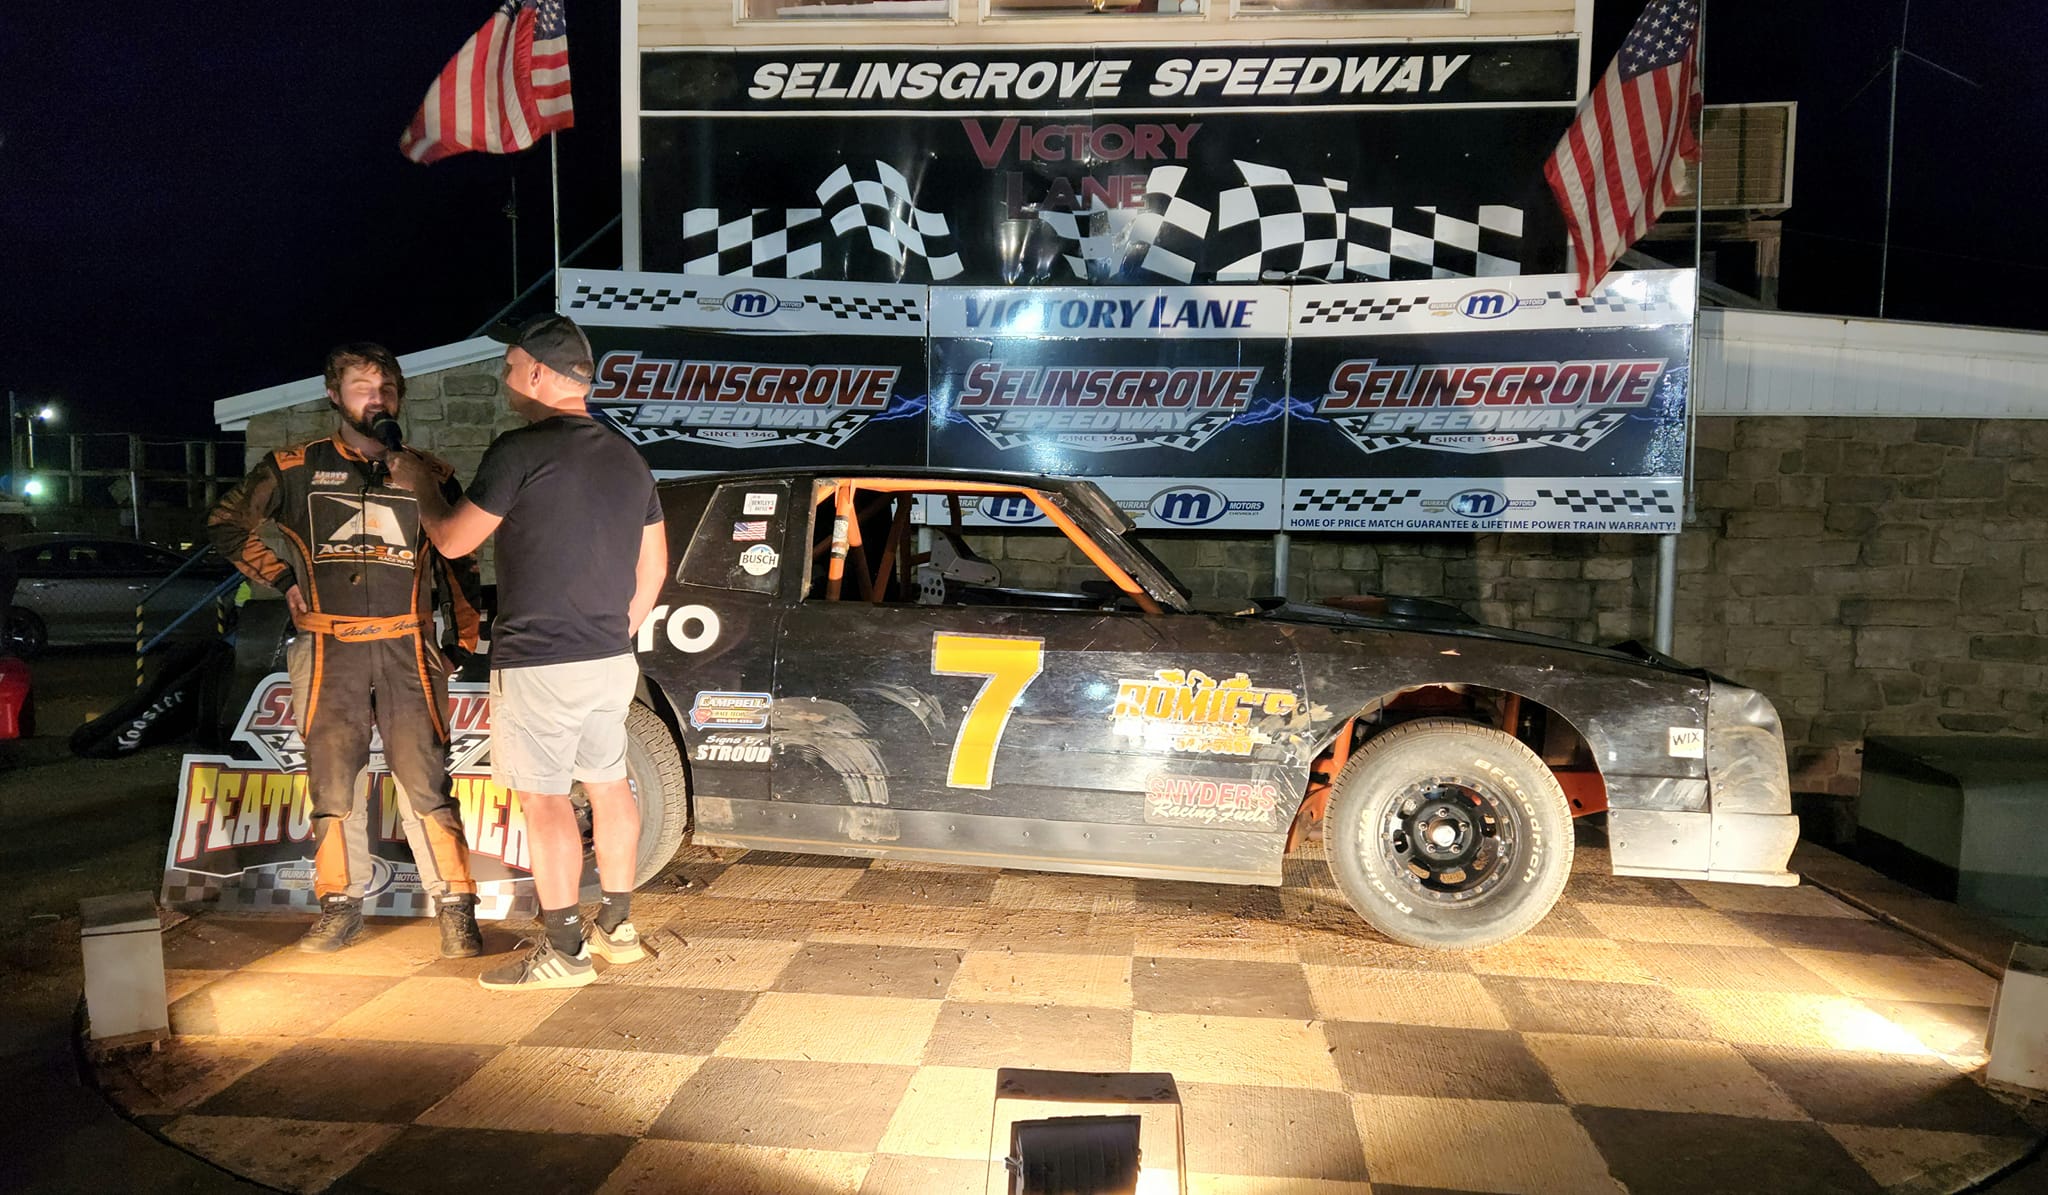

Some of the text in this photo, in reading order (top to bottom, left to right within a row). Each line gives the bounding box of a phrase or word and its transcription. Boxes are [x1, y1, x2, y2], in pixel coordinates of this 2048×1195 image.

[748, 54, 1470, 99] SELINSGROVE SPEEDWAY
[961, 118, 1203, 169] VICTORY
[1006, 171, 1148, 220] LANE
[1148, 295, 1257, 328] LANE
[591, 353, 898, 408] SELINSGROVE
[957, 362, 1260, 408] SELINSGROVE
[1323, 362, 1665, 408] SELINSGROVE
[637, 404, 841, 427] SPEEDWAY
[1002, 411, 1196, 432] SPEEDWAY
[1367, 409, 1592, 432] SPEEDWAY
[702, 430, 776, 439] SINCE 1946
[1062, 435, 1099, 443] SINCE
[1435, 435, 1516, 443] SINCE 1946
[1115, 501, 1149, 509] MURRAY
[1229, 501, 1262, 510] MOTORS
[1290, 518, 1676, 531] HOME OF PRICE MATCH GUARANTEE & LIFETIME POWER TRAIN WARRANTY!
[318, 543, 414, 560] ACCELO
[742, 554, 777, 566] BUSCH
[931, 630, 1045, 790] 7
[1672, 731, 1701, 746] WIX
[695, 744, 771, 762] STROUD
[1146, 777, 1278, 812] SNYDER'S
[1152, 801, 1270, 824] Racing Fuels
[280, 870, 422, 882] MURRAY MOTOR
